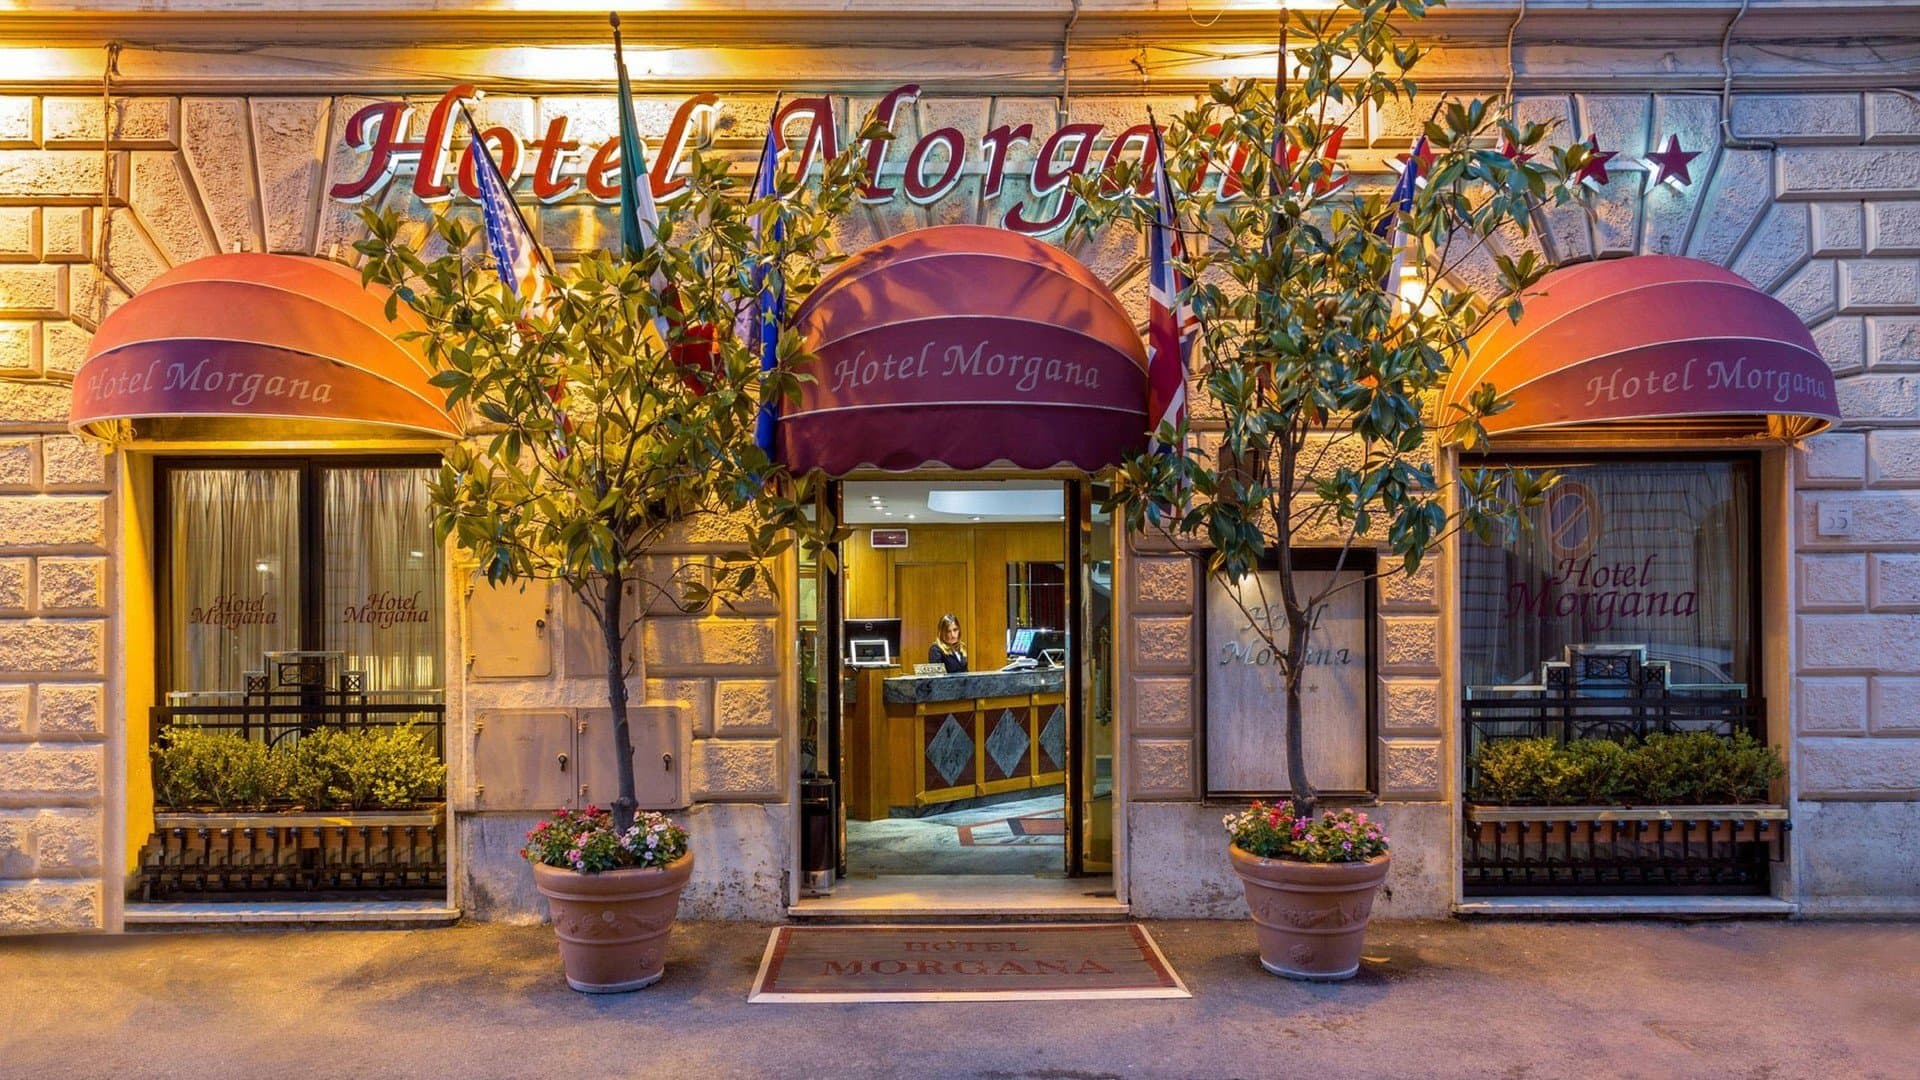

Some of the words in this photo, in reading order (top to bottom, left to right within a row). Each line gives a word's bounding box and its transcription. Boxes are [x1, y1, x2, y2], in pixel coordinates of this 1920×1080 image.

[331, 83, 724, 206] Hotel
[826, 341, 936, 393] Hotel
[943, 340, 1103, 392] Morgana
[86, 359, 161, 404] Hotel
[163, 359, 334, 406] Morgana
[1584, 358, 1697, 407] Hotel
[1707, 357, 1828, 403] Morgana
[1549, 553, 1658, 588] Hotel
[209, 592, 270, 613] Hotel
[360, 590, 423, 611] Hotel
[1503, 579, 1700, 633] Morgana
[190, 605, 278, 631] Morgana
[343, 604, 430, 630] Morgana
[903, 940, 1029, 953] HOTEL
[822, 957, 1114, 977] MORGANA
